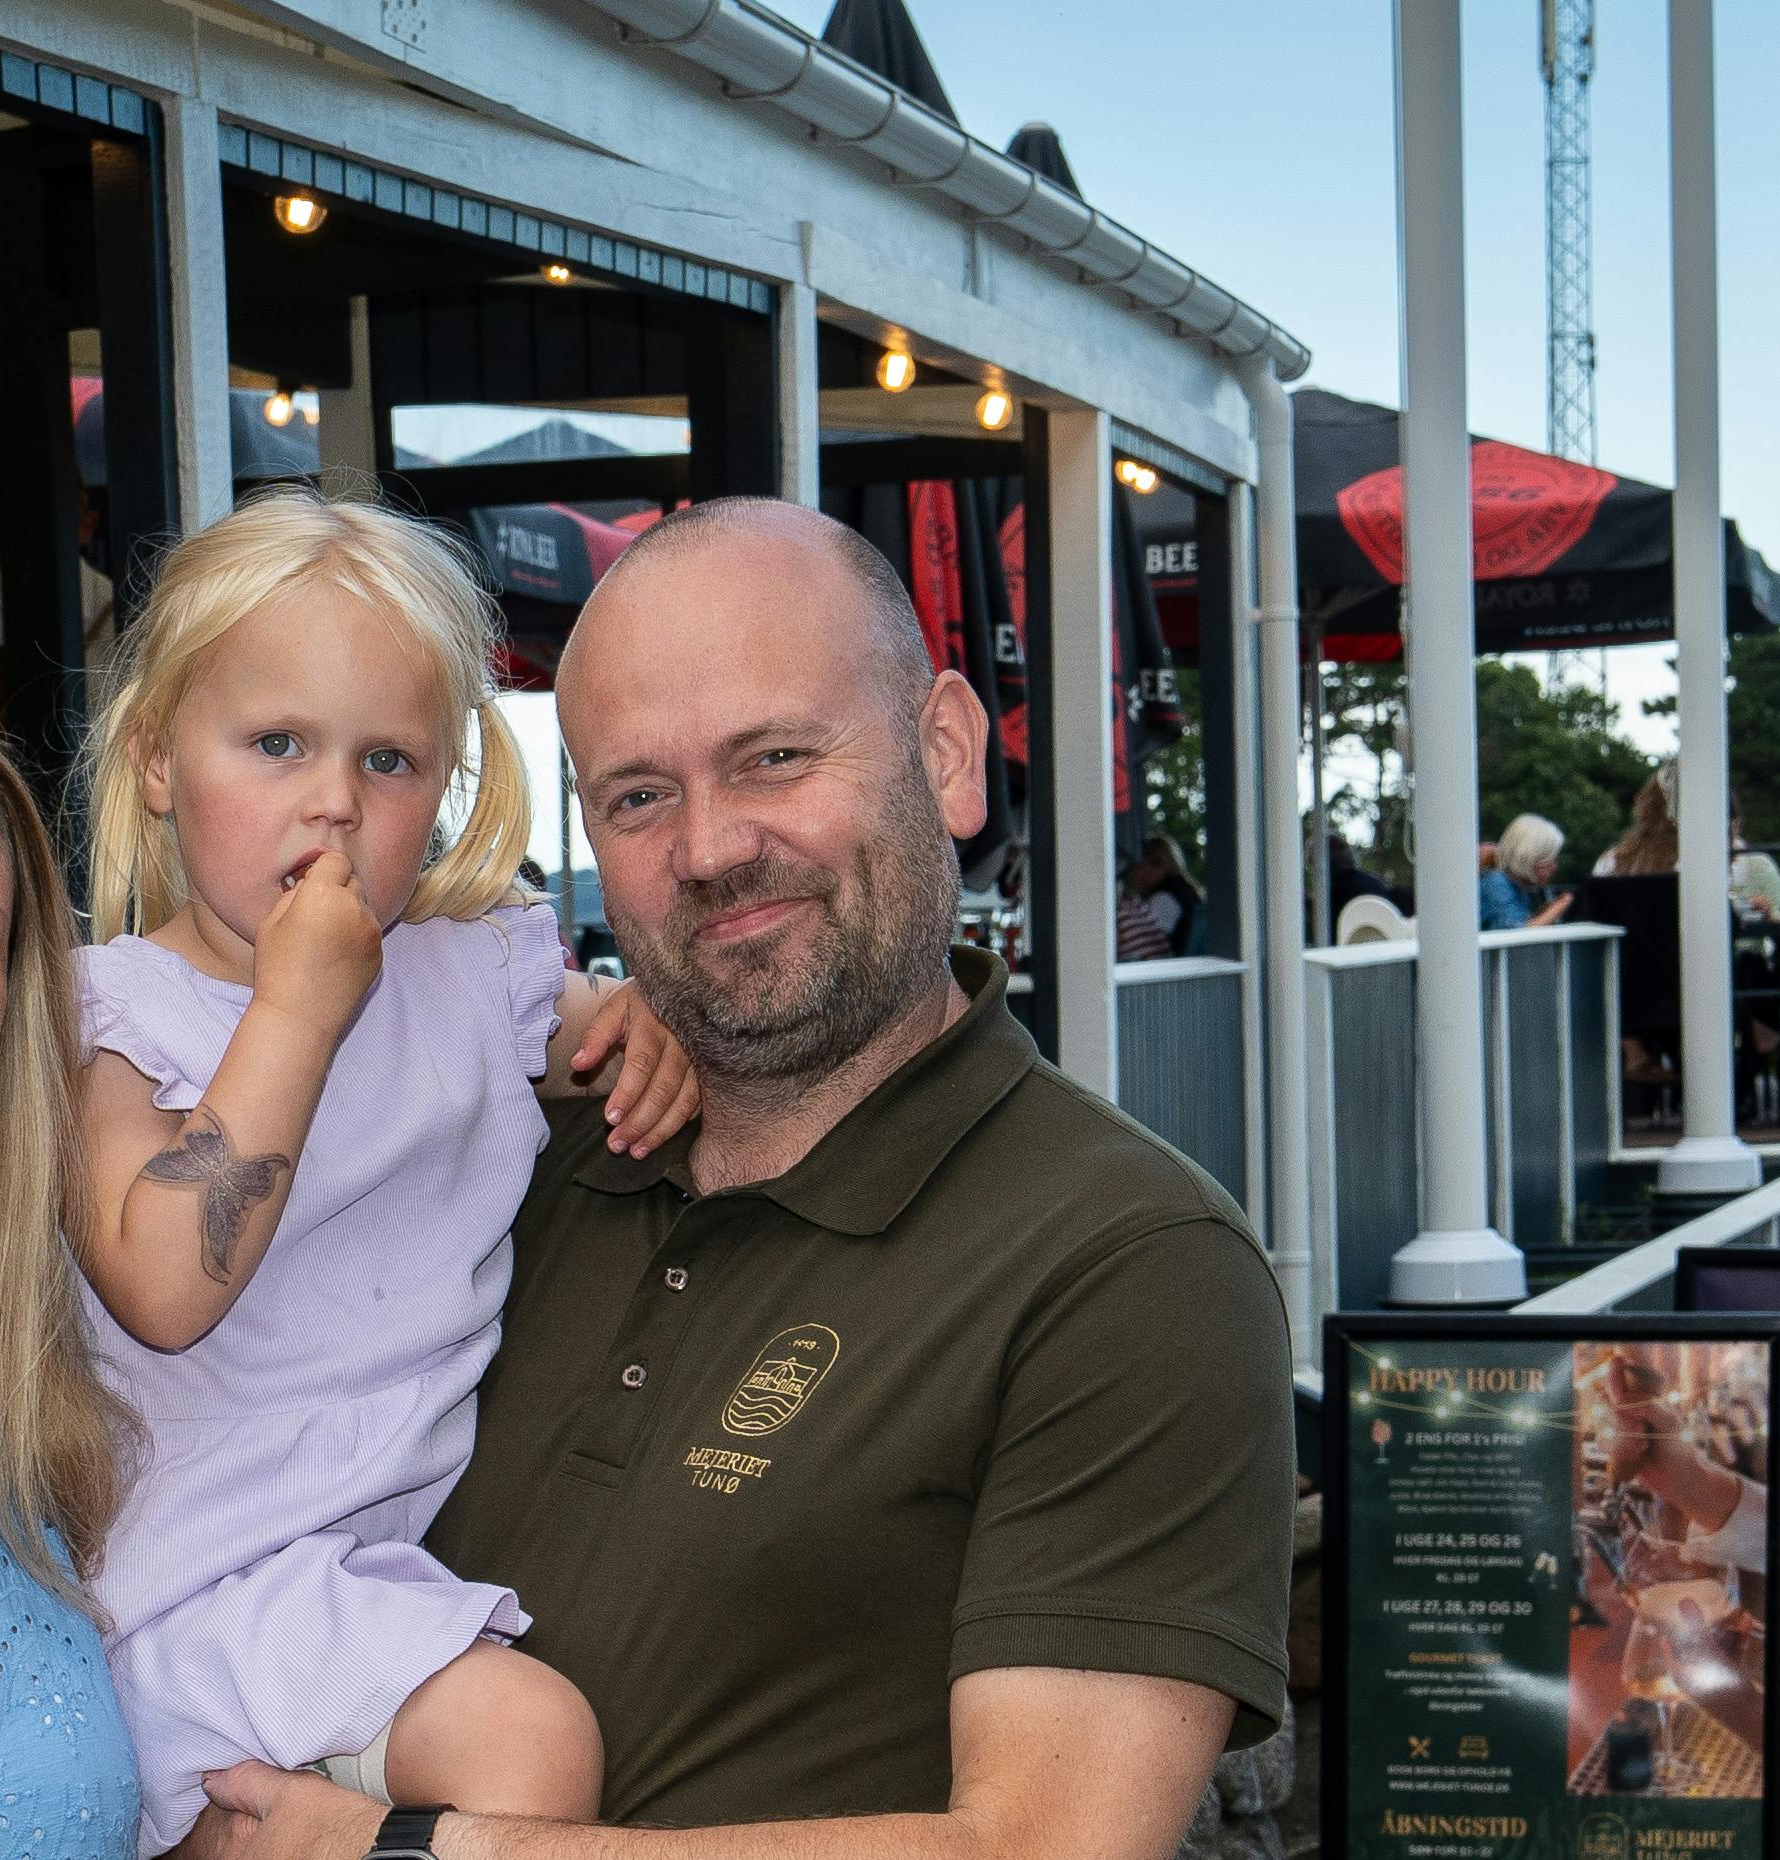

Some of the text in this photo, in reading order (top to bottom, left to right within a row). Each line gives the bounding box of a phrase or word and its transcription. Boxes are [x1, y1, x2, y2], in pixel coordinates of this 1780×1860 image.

[1144, 542, 1199, 574] BEE
[1370, 1367, 1546, 1394] HAPPY HOUR
[683, 1447, 772, 1479] MEJERIET
[692, 1470, 742, 1495] TUNØ
[1403, 1533, 1434, 1547] UGE
[1479, 1534, 1501, 1547] OG
[1503, 1534, 1522, 1549] 26
[1391, 1600, 1420, 1614] UGE
[1488, 1601, 1511, 1615] OG
[1382, 1808, 1530, 1839] ÅBNINGSTID
[1636, 1829, 1737, 1850] MEJERIET
